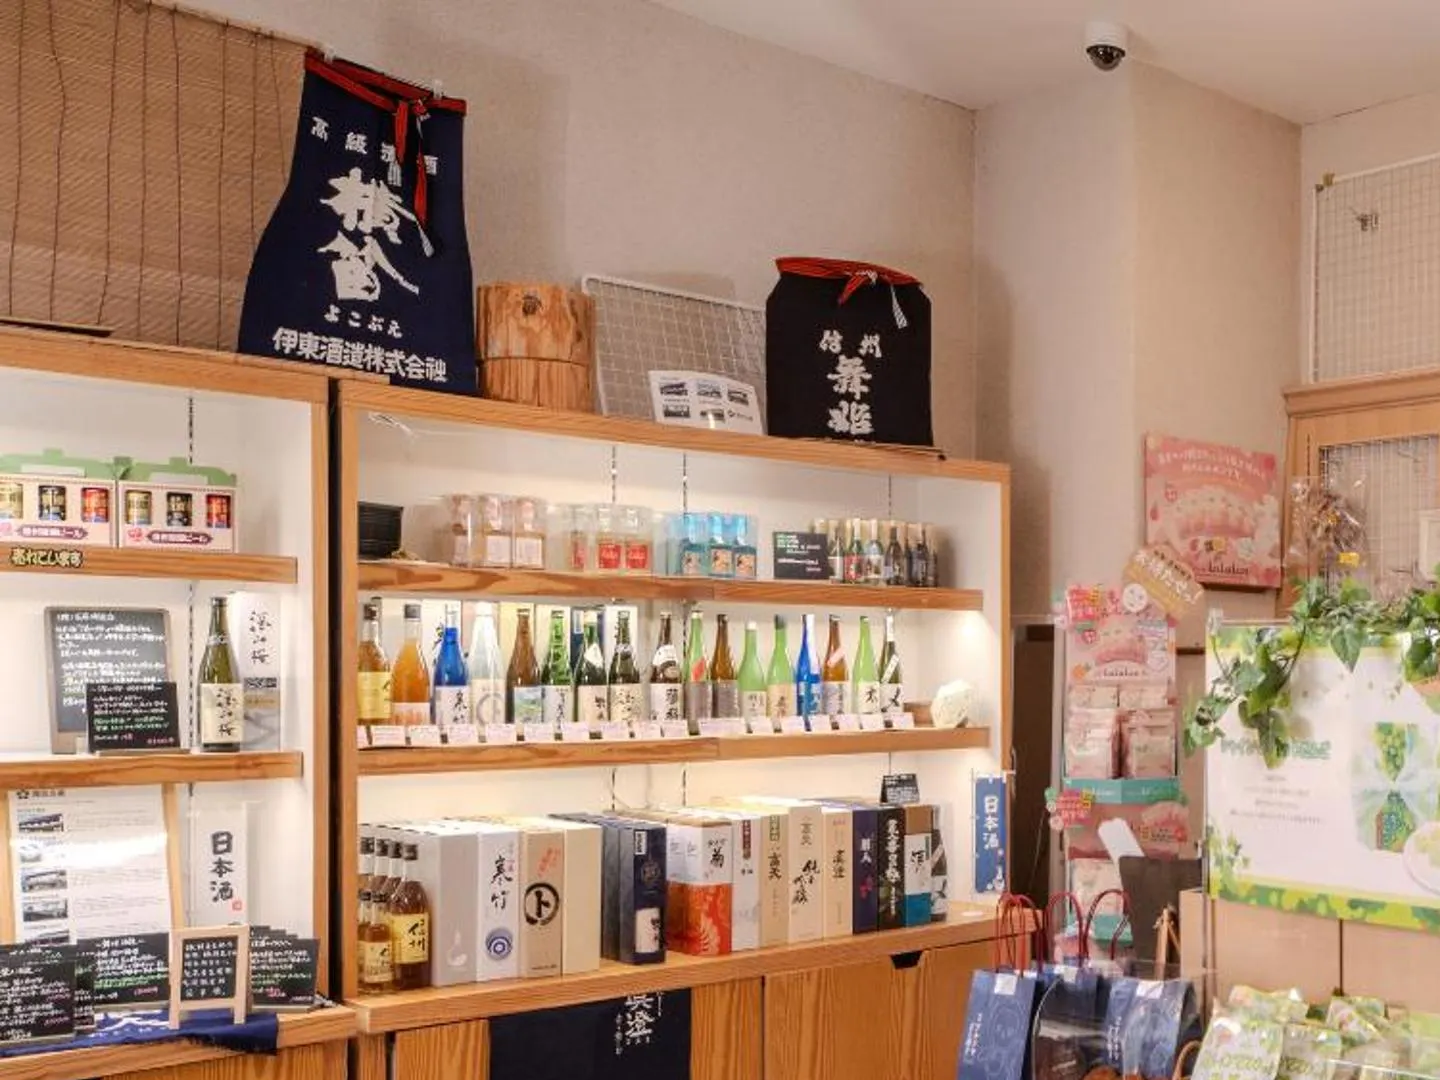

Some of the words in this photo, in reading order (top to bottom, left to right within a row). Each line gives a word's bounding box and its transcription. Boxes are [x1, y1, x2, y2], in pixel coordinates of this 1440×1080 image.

[323, 303, 404, 339] よこぶえ
[271, 325, 450, 383] 伊東酒造株式会社
[982, 795, 1000, 850] 日本酒
[209, 831, 234, 903] 日本酒
